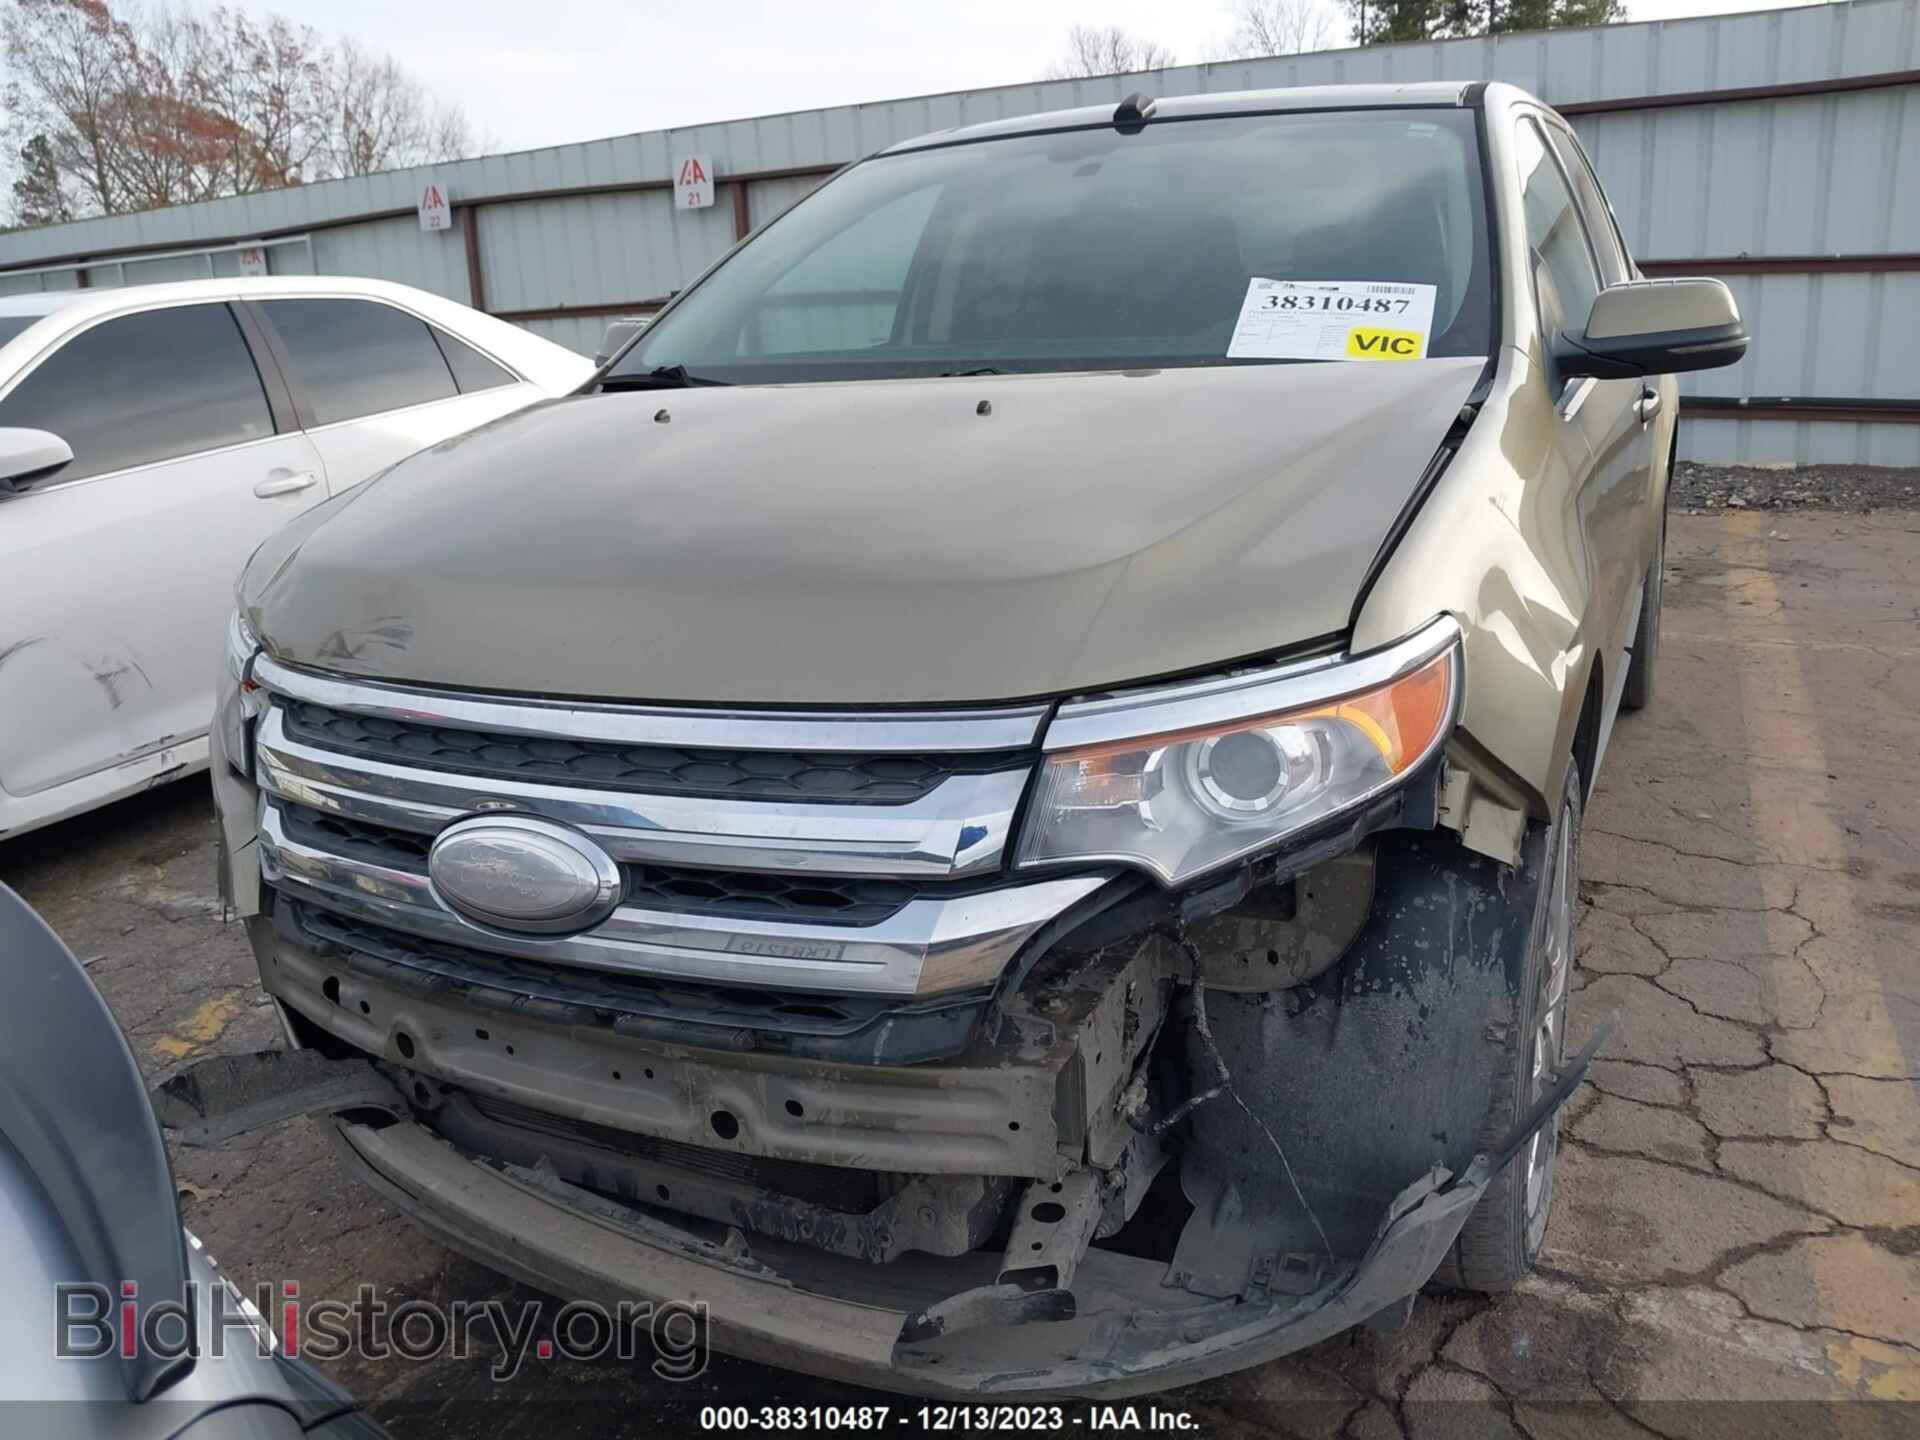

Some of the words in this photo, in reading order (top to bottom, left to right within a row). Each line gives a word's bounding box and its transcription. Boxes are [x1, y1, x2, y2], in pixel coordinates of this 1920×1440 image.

[687, 192, 701, 206] 21
[1261, 295, 1410, 314] 38310487
[1354, 333, 1416, 355] VIC
